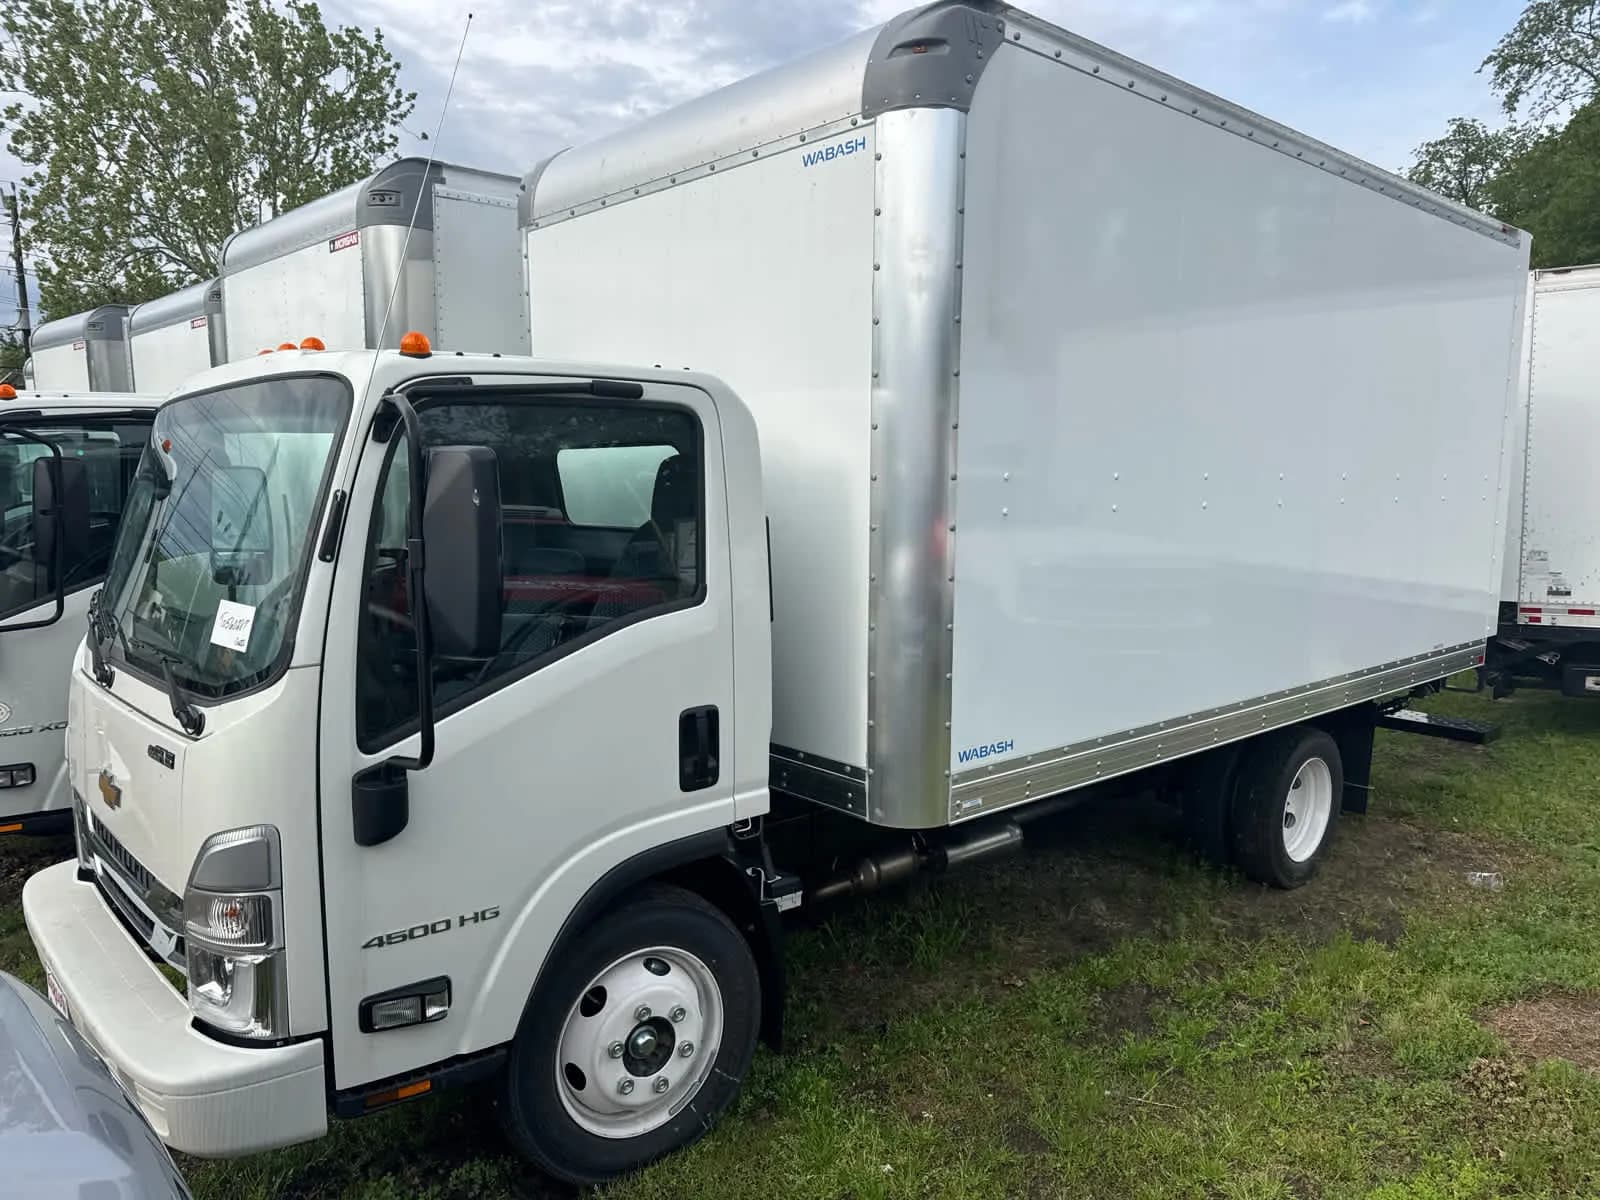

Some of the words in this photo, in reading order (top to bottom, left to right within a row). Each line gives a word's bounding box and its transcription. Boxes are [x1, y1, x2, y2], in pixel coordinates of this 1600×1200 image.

[802, 136, 866, 168] WABASH
[958, 739, 1014, 763] WABASH
[362, 918, 451, 949] 4500
[459, 905, 500, 928] HG
